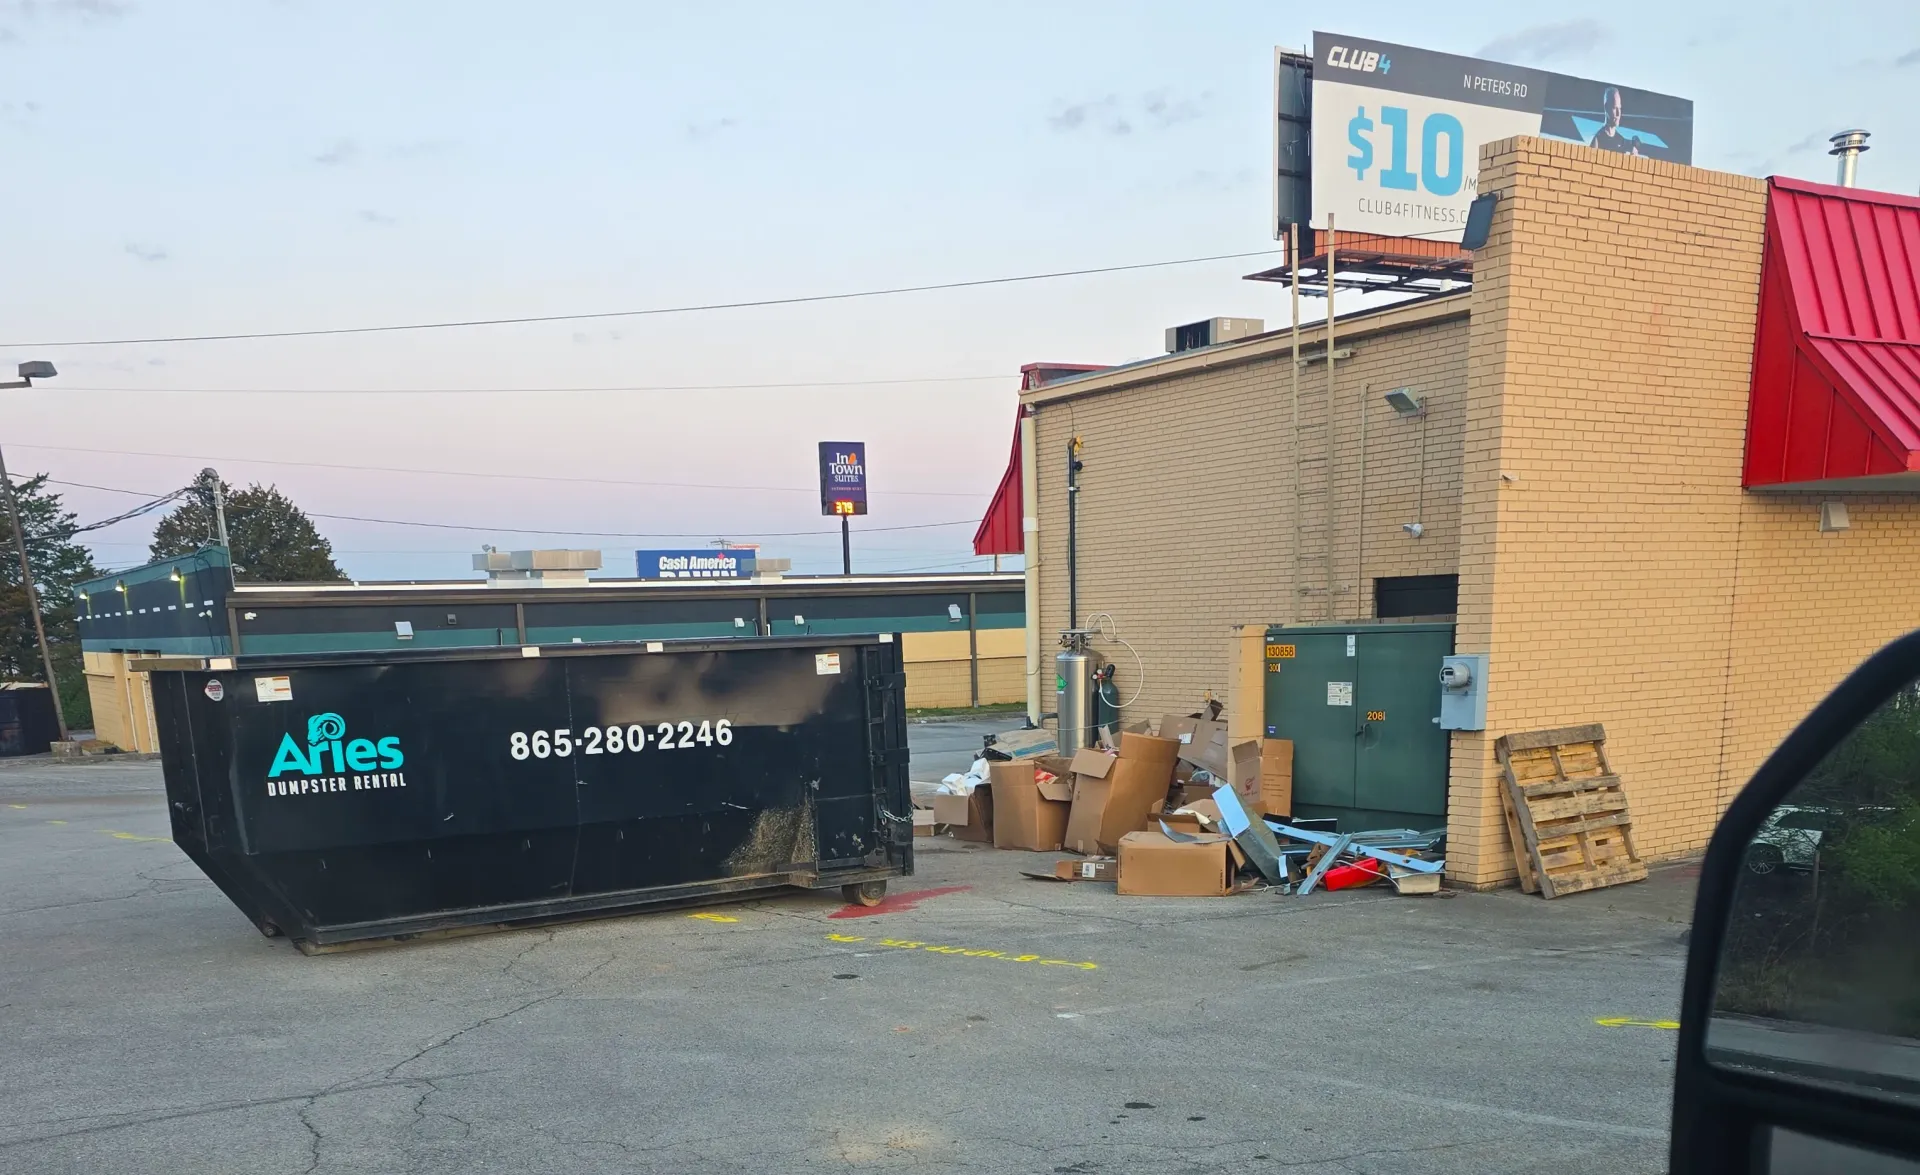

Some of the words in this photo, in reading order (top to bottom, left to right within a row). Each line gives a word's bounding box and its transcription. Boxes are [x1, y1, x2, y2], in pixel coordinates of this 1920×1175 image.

[1327, 45, 1391, 75] CLUB4
[1463, 74, 1472, 89] N
[1474, 76, 1511, 95] PETERS
[1513, 83, 1528, 98] RD
[1347, 105, 1464, 197] $10
[836, 452, 849, 465] In
[829, 462, 863, 475] Town
[834, 474, 859, 482] SUITES
[659, 556, 688, 570] Cash
[689, 555, 736, 570] America
[1267, 646, 1294, 657] 130858
[267, 731, 404, 778] Aries
[267, 777, 347, 797] DUMPSTER
[353, 772, 407, 790] RENTAL
